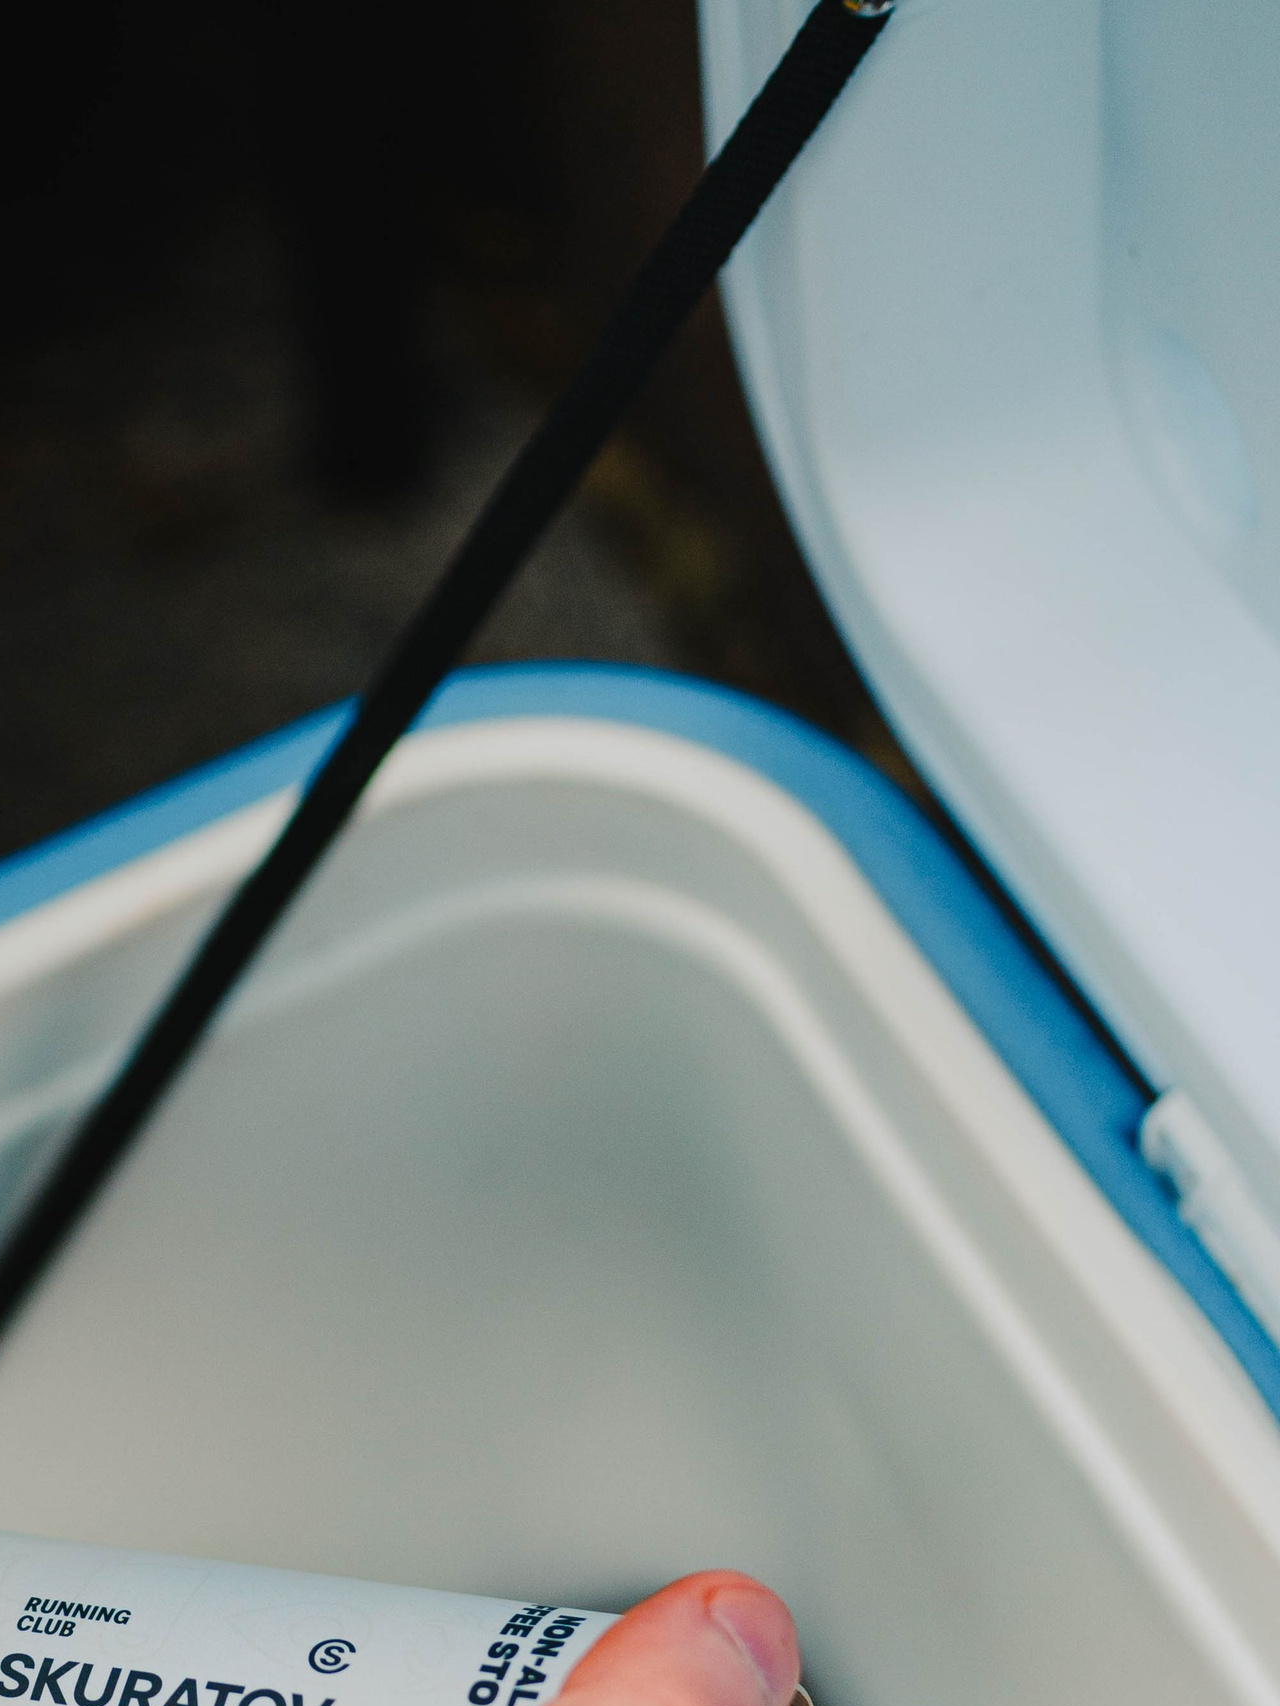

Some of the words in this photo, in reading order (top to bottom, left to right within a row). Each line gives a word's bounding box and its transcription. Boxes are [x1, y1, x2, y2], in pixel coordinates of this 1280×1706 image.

[23, 1596, 132, 1626] RUNNING
[499, 1603, 560, 1638] FFEE
[16, 1615, 77, 1638] CLUB
